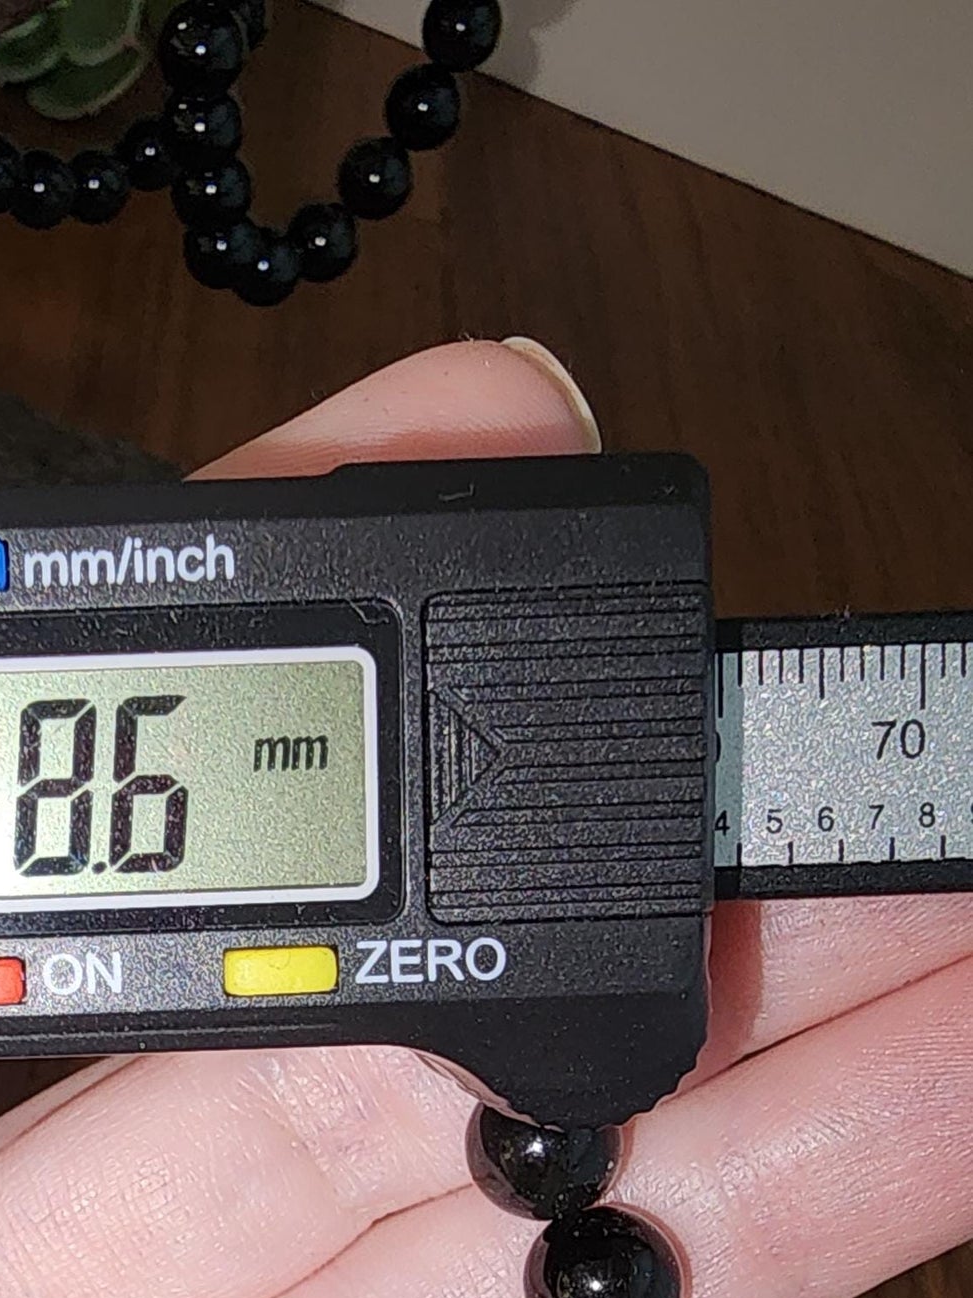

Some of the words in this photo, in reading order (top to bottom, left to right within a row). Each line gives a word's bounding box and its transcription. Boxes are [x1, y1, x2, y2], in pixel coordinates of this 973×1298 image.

[24, 533, 235, 588] mm/inch
[872, 718, 926, 760] 70
[13, 694, 189, 877] 8.6
[253, 734, 329, 773] mm
[714, 810, 730, 836] 4
[766, 808, 784, 834] 5
[817, 806, 835, 832] 6
[868, 804, 885, 830] 7
[918, 802, 936, 828] 8
[42, 952, 123, 996] ON
[354, 936, 508, 985] ZERO
